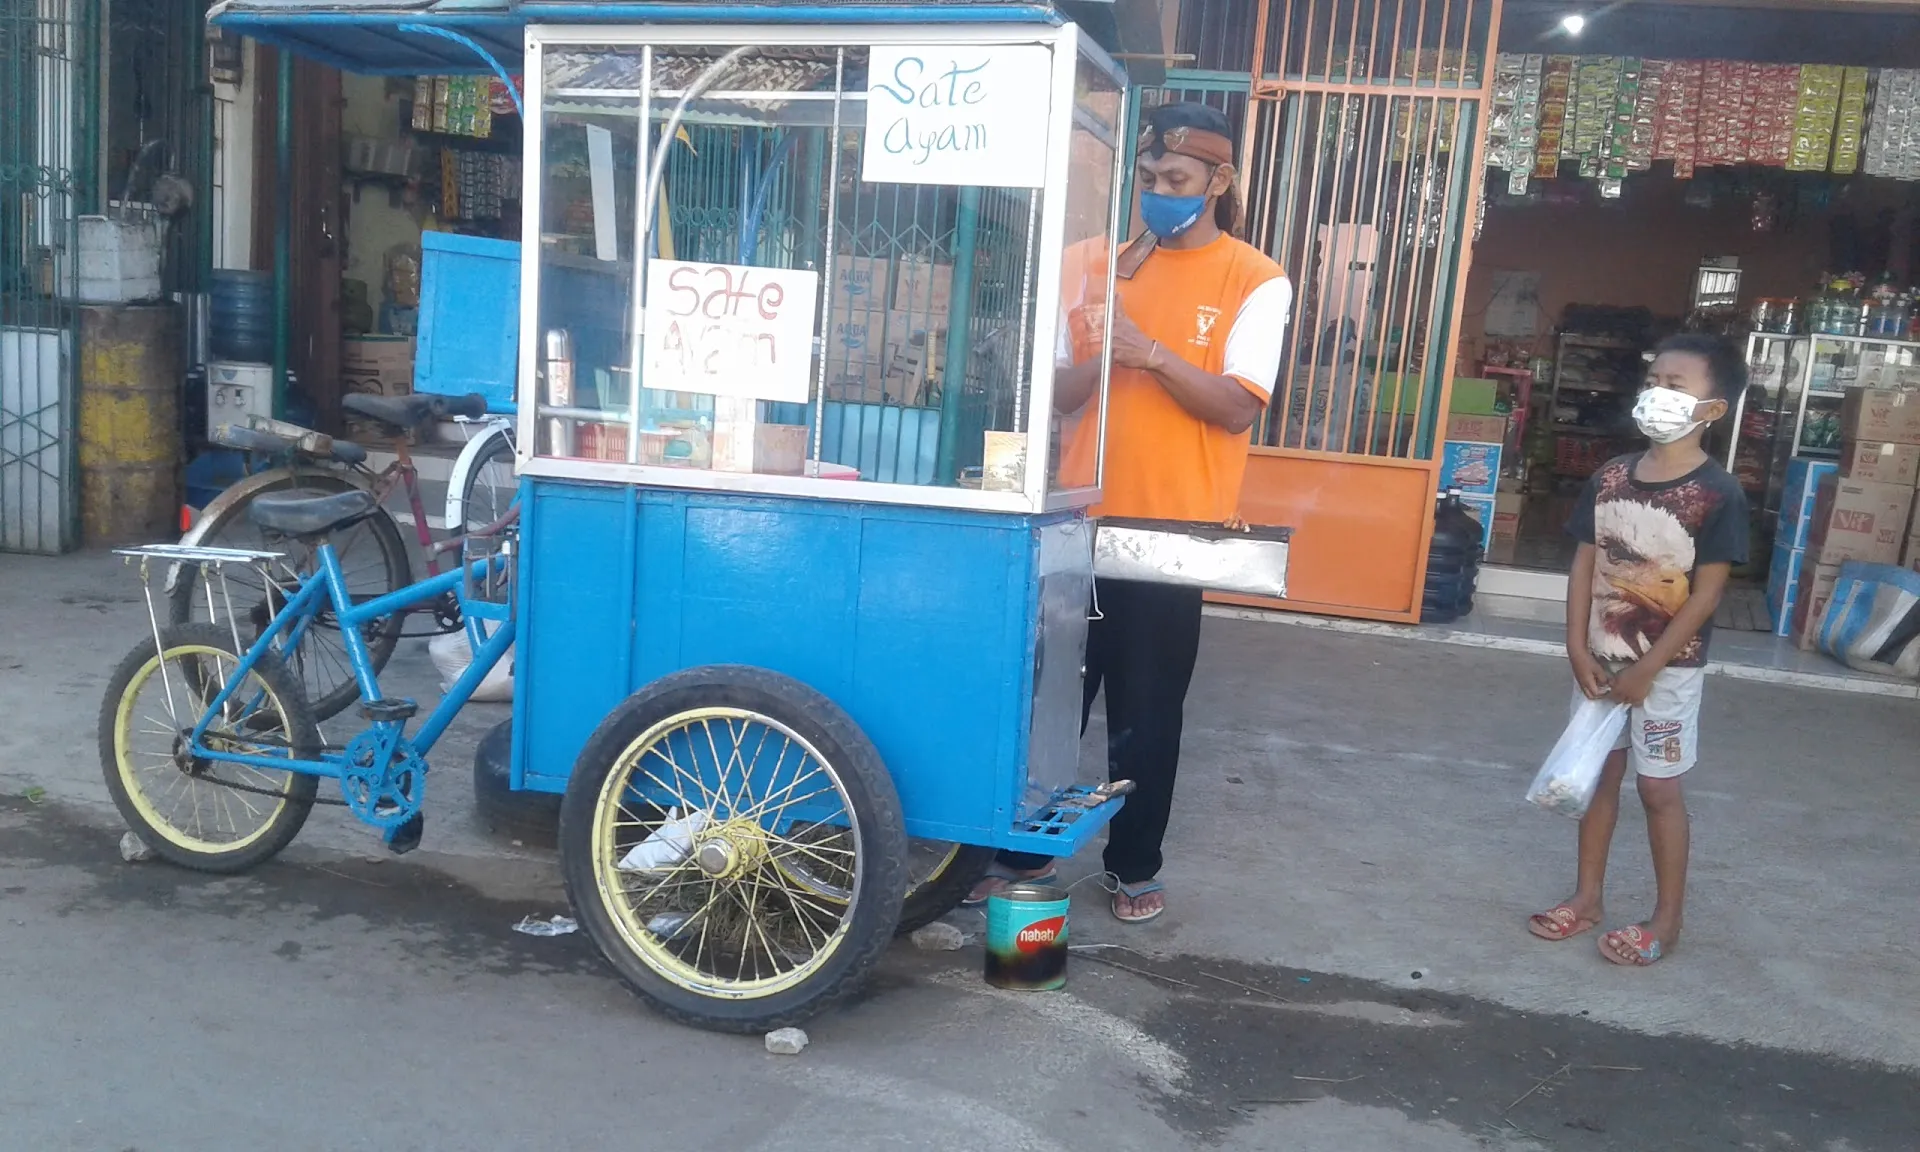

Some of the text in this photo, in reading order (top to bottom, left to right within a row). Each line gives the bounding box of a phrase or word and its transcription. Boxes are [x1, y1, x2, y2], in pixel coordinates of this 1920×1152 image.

[869, 56, 991, 108] Sate
[667, 266, 784, 320] Sate
[1020, 928, 1054, 942] nabati
